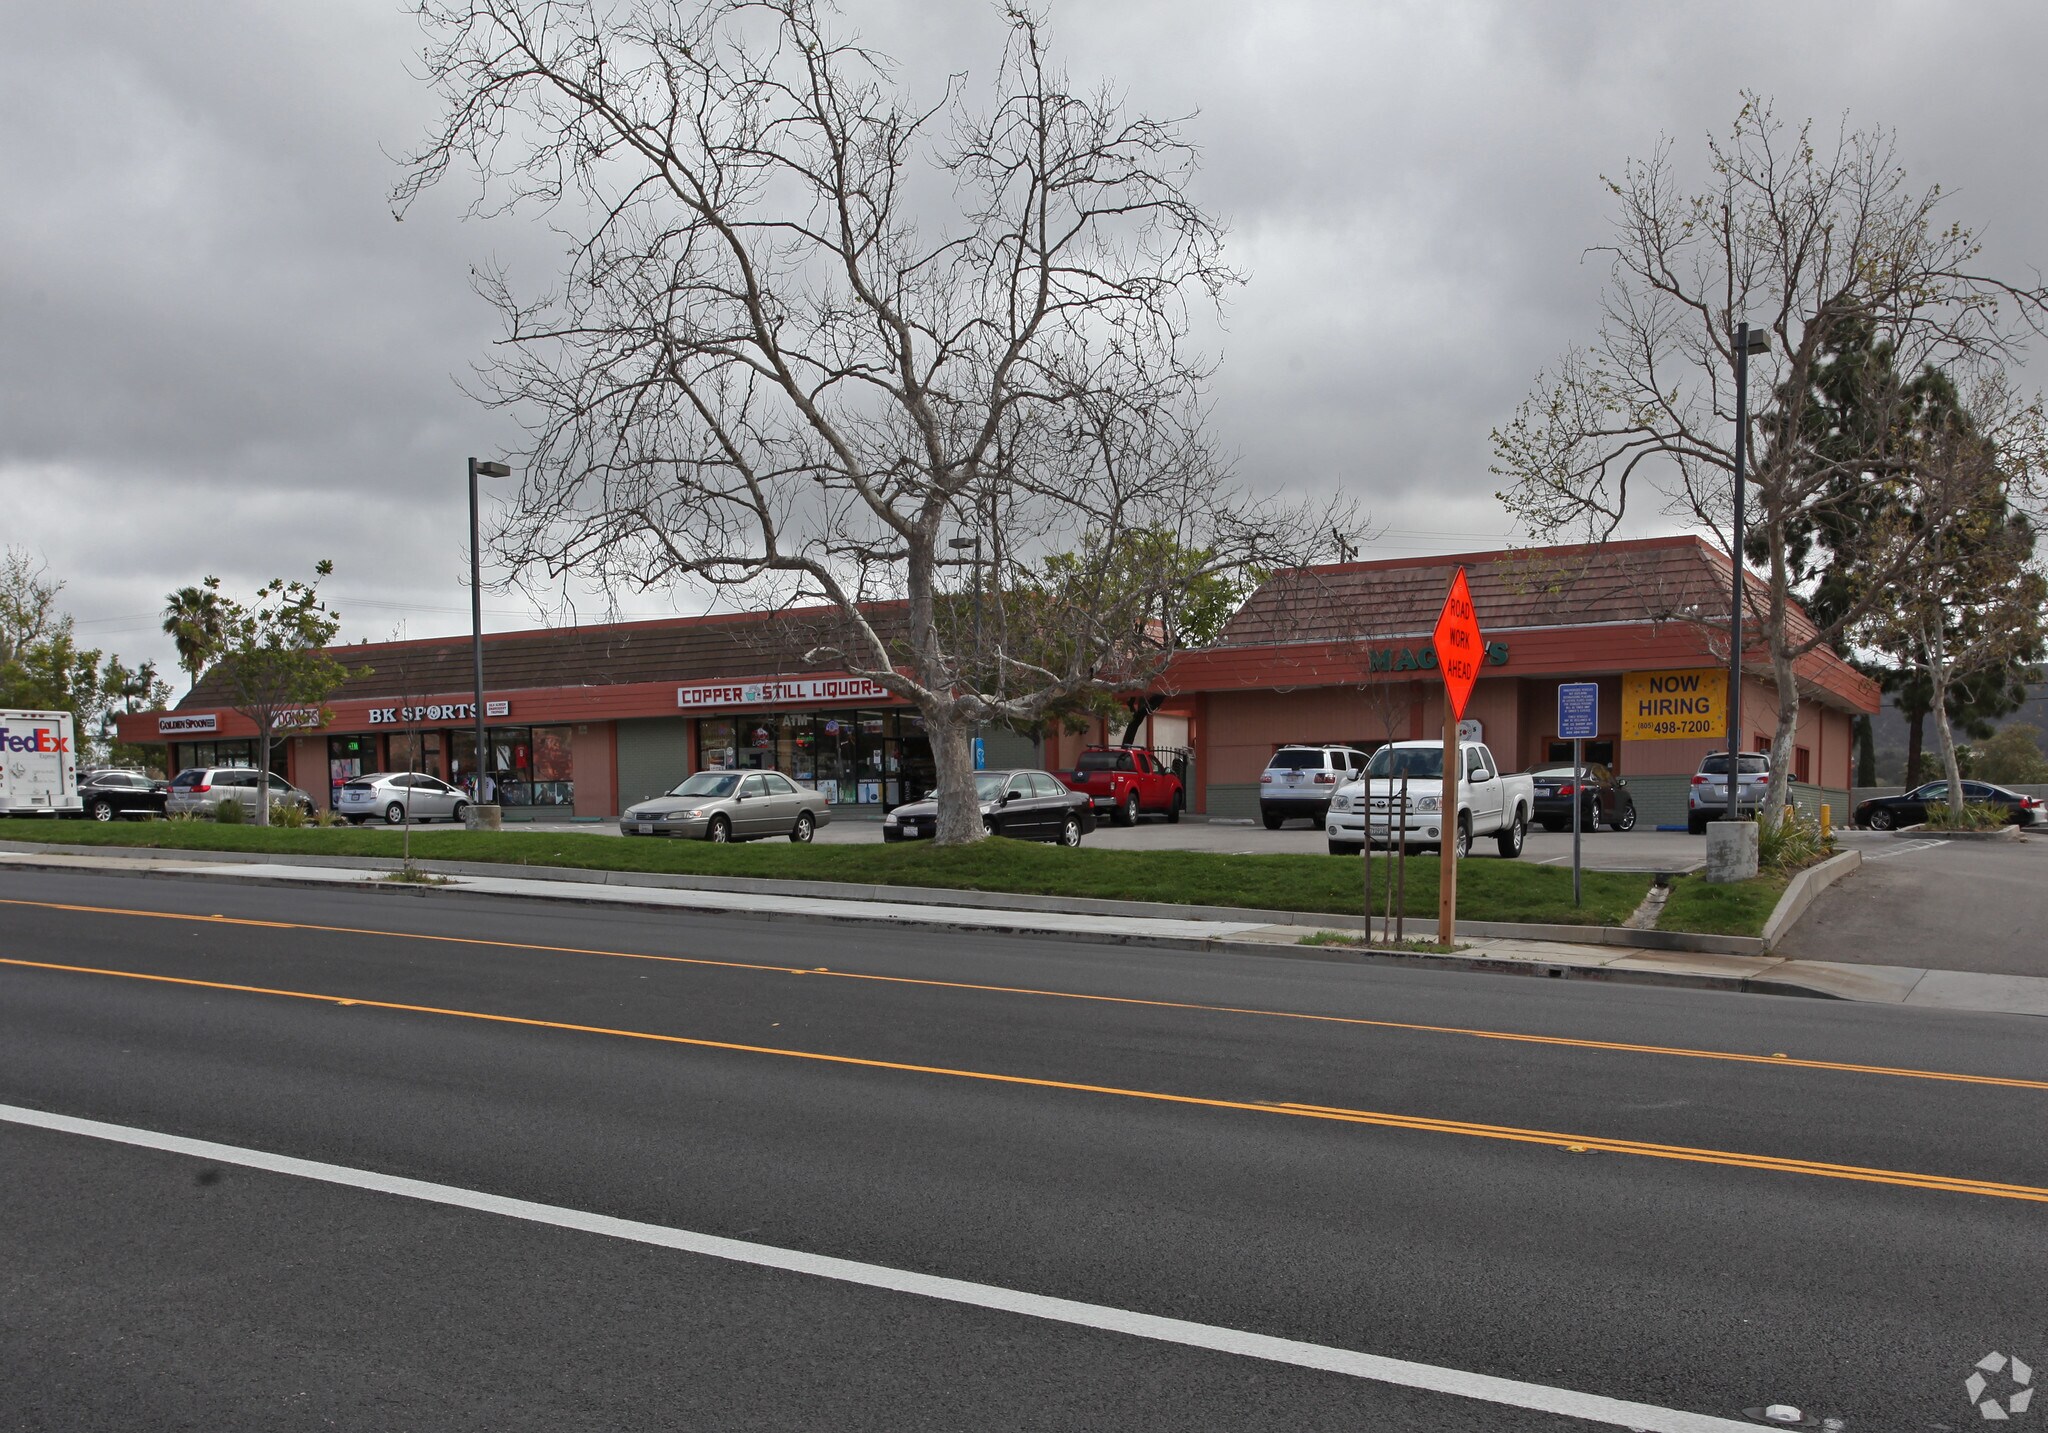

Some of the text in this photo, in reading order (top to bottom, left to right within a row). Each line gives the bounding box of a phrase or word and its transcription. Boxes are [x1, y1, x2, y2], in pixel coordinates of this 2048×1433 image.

[1451, 599, 1470, 620] ROAD
[1450, 628, 1470, 649] WORK
[1369, 641, 1509, 672] MAG'S
[1447, 659, 1471, 680] AHEAD
[681, 680, 883, 704] COPPER STILL LIQUORS
[1650, 675, 1700, 693] NOW
[368, 708, 397, 724] BK
[1639, 697, 1710, 716] HIRING
[159, 719, 185, 730] GOLDEN
[185, 718, 207, 729] SPOON
[782, 714, 808, 726] ATM
[1654, 720, 1710, 734] 498-7200
[0, 728, 69, 753] FedEx
